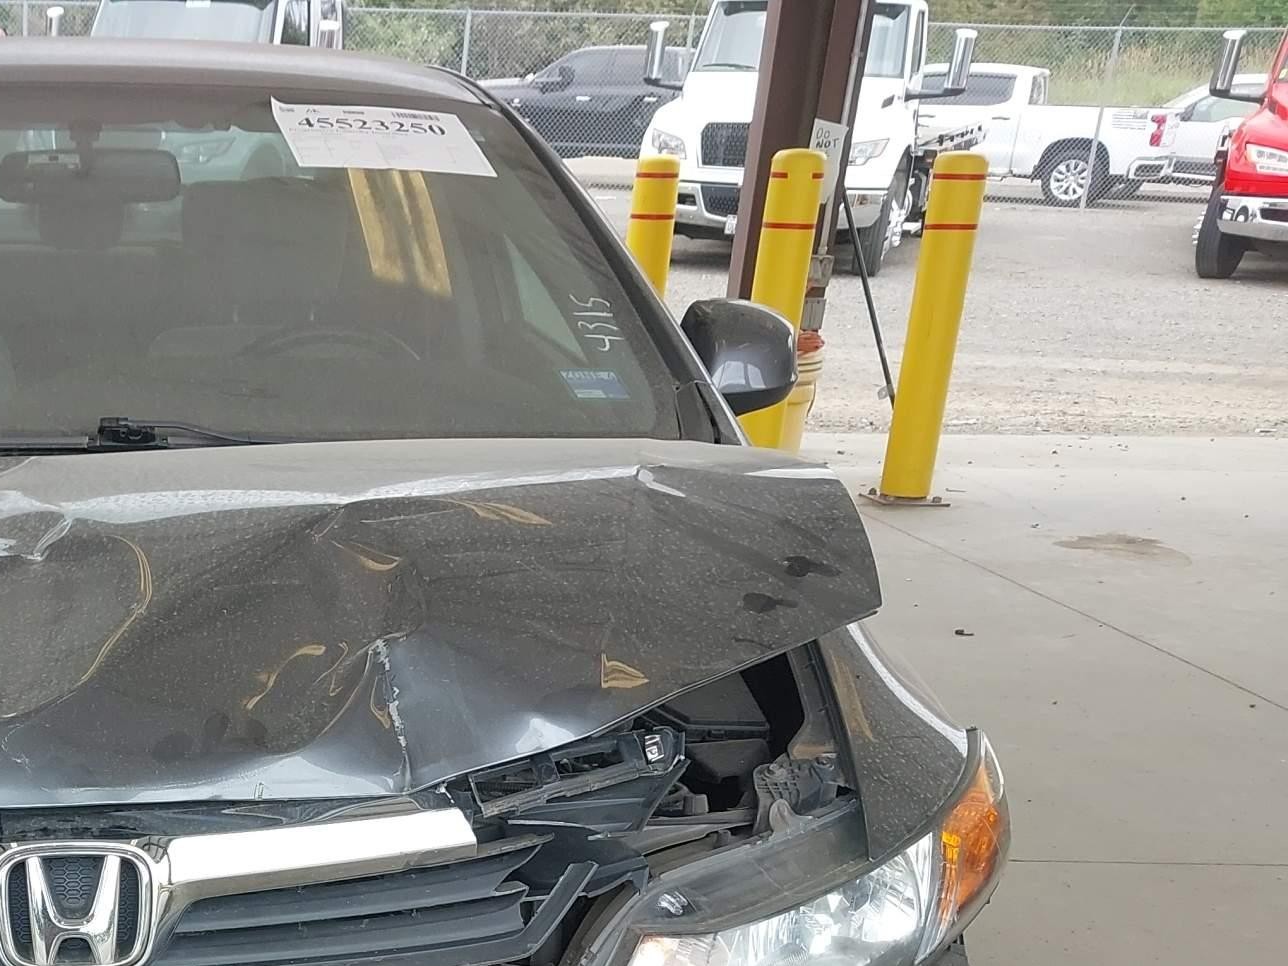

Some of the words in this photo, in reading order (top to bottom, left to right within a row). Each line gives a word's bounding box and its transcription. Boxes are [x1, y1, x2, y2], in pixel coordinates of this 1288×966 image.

[297, 116, 446, 136] 45523250
[815, 127, 831, 140] DO
[815, 137, 839, 149] NOT
[569, 293, 624, 351] 4315
